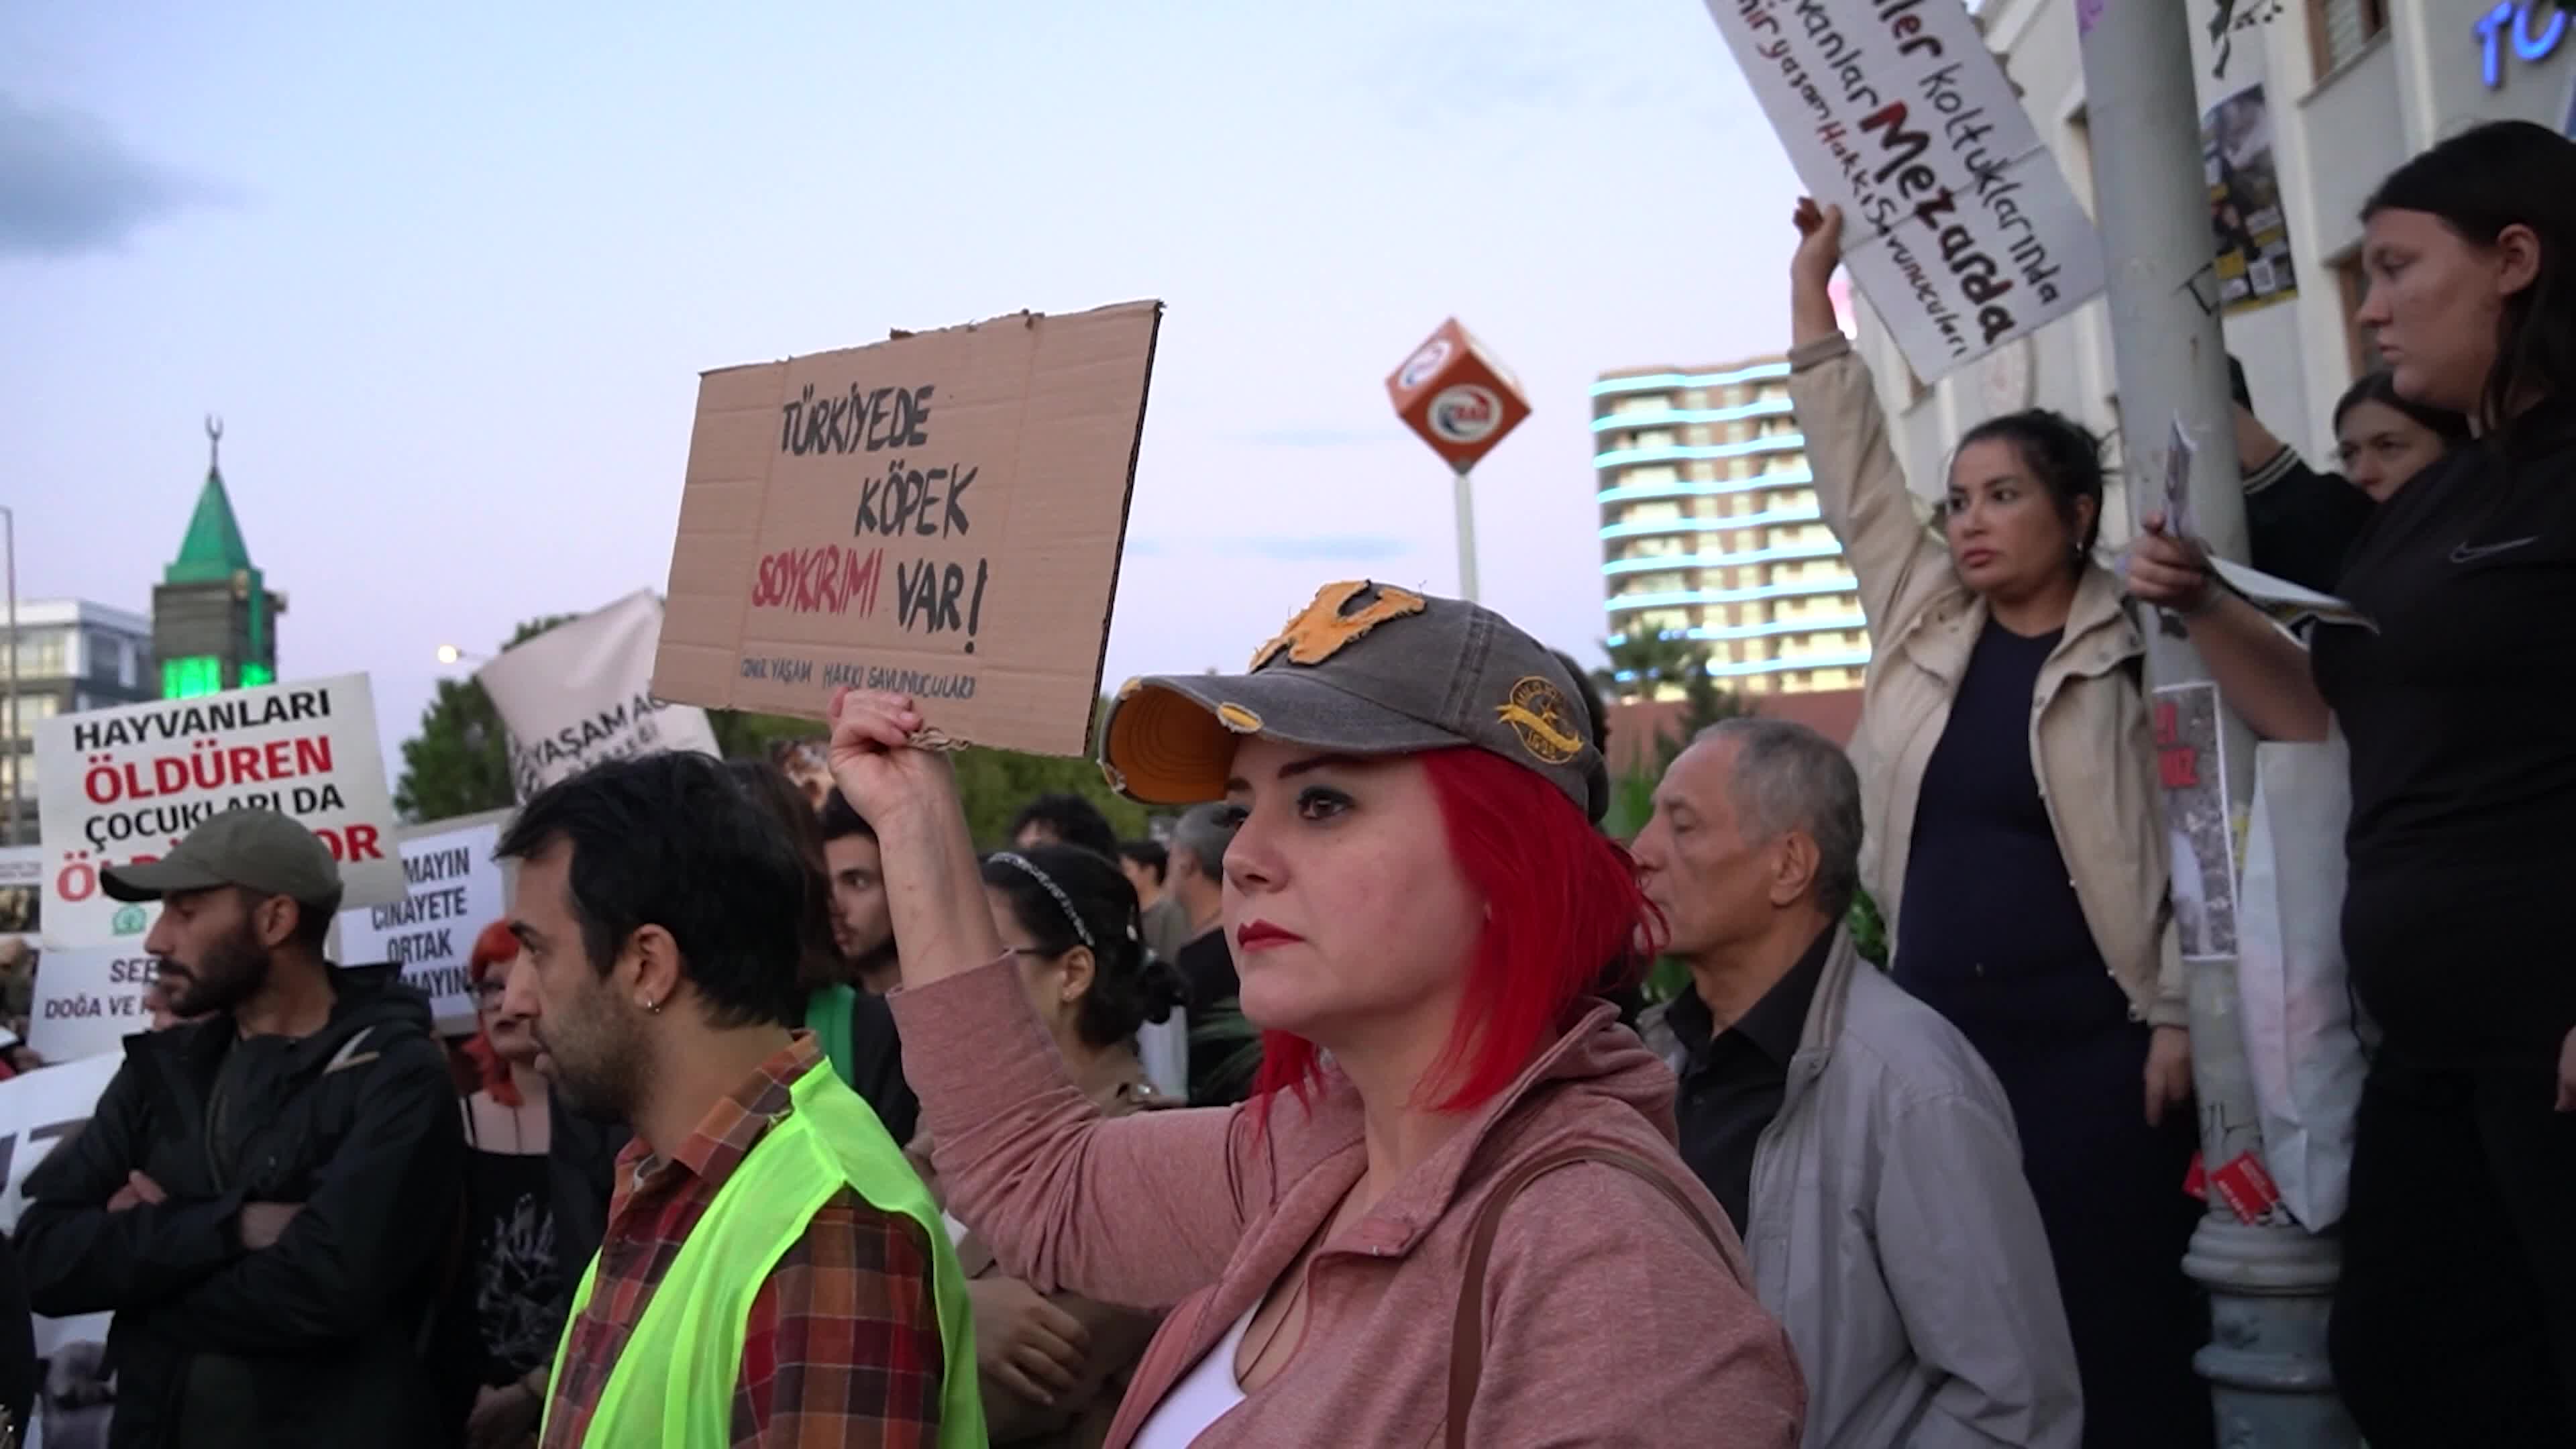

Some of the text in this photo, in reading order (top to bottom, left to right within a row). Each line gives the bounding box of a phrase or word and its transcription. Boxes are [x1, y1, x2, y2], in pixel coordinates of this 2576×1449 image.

[1792, 0, 2017, 345] vanlar Mezarda
[781, 382, 936, 455] TÜRKİYEDE
[853, 459, 979, 539] KÖPEK
[752, 544, 883, 618] SOYKIRIMI
[74, 689, 331, 752] HAYVANLARI
[85, 735, 333, 804] ÖLDÜREN
[292, 784, 345, 815] DA
[387, 928, 453, 965] ORTAK
[44, 992, 101, 1019] DOĞA
[109, 996, 136, 1016] VE
